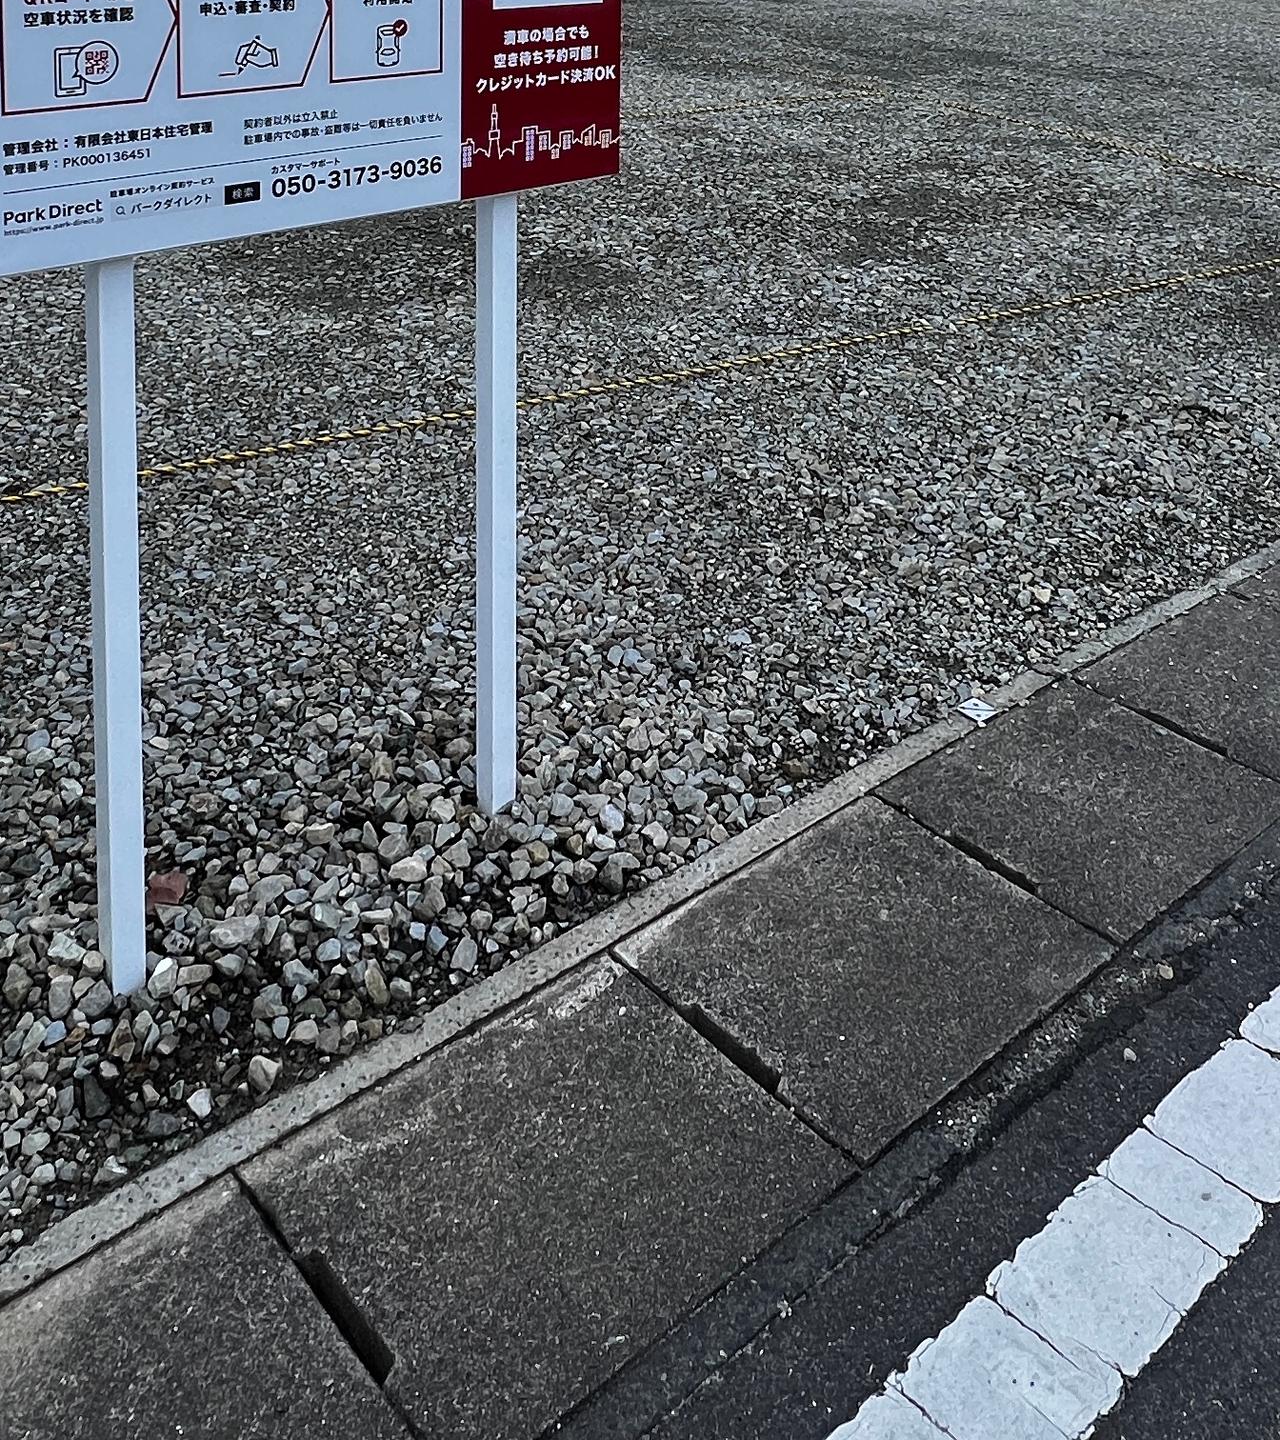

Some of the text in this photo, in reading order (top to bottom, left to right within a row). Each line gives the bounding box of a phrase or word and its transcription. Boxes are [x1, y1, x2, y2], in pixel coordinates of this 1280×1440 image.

[23, 7, 135, 28] 空車状況を確認
[504, 24, 589, 46] 満車の場合でも
[476, 65, 616, 94] クレジットカード決済OK
[243, 109, 339, 130] 契約者以外は立入禁止
[271, 157, 341, 175] カスタマーサポート
[271, 155, 443, 198] 050-3173-9036
[231, 186, 254, 200] 検索
[3, 199, 103, 226] Park Direct
